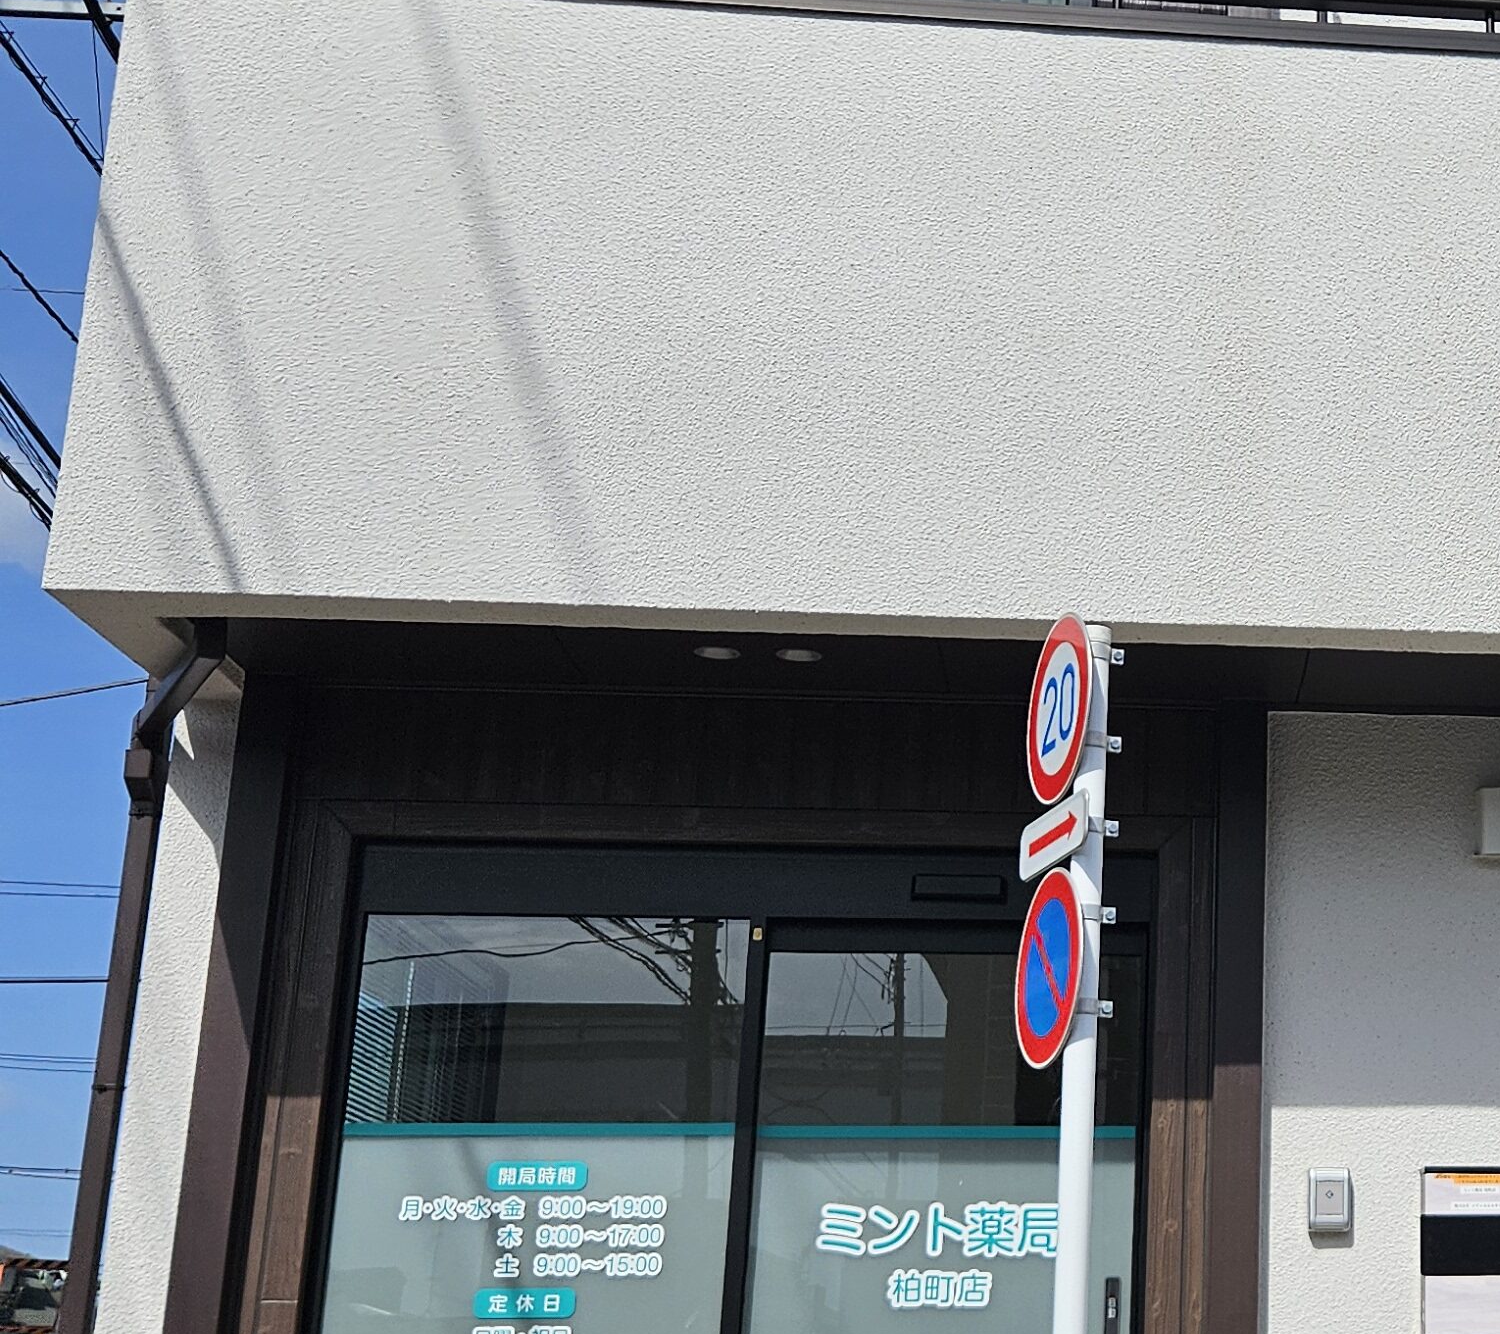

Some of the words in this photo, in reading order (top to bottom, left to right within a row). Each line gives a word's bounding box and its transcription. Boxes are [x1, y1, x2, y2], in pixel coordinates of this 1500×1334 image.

[1041, 661, 1075, 758] 20
[498, 1167, 576, 1186] 開局時間
[399, 1196, 526, 1221] 月・火・水・金
[497, 1224, 522, 1248] 木
[816, 1201, 1060, 1258] ミント薬局
[494, 1253, 519, 1277] 土
[888, 1269, 992, 1308] 柏町店
[488, 1295, 561, 1313] 定休日
